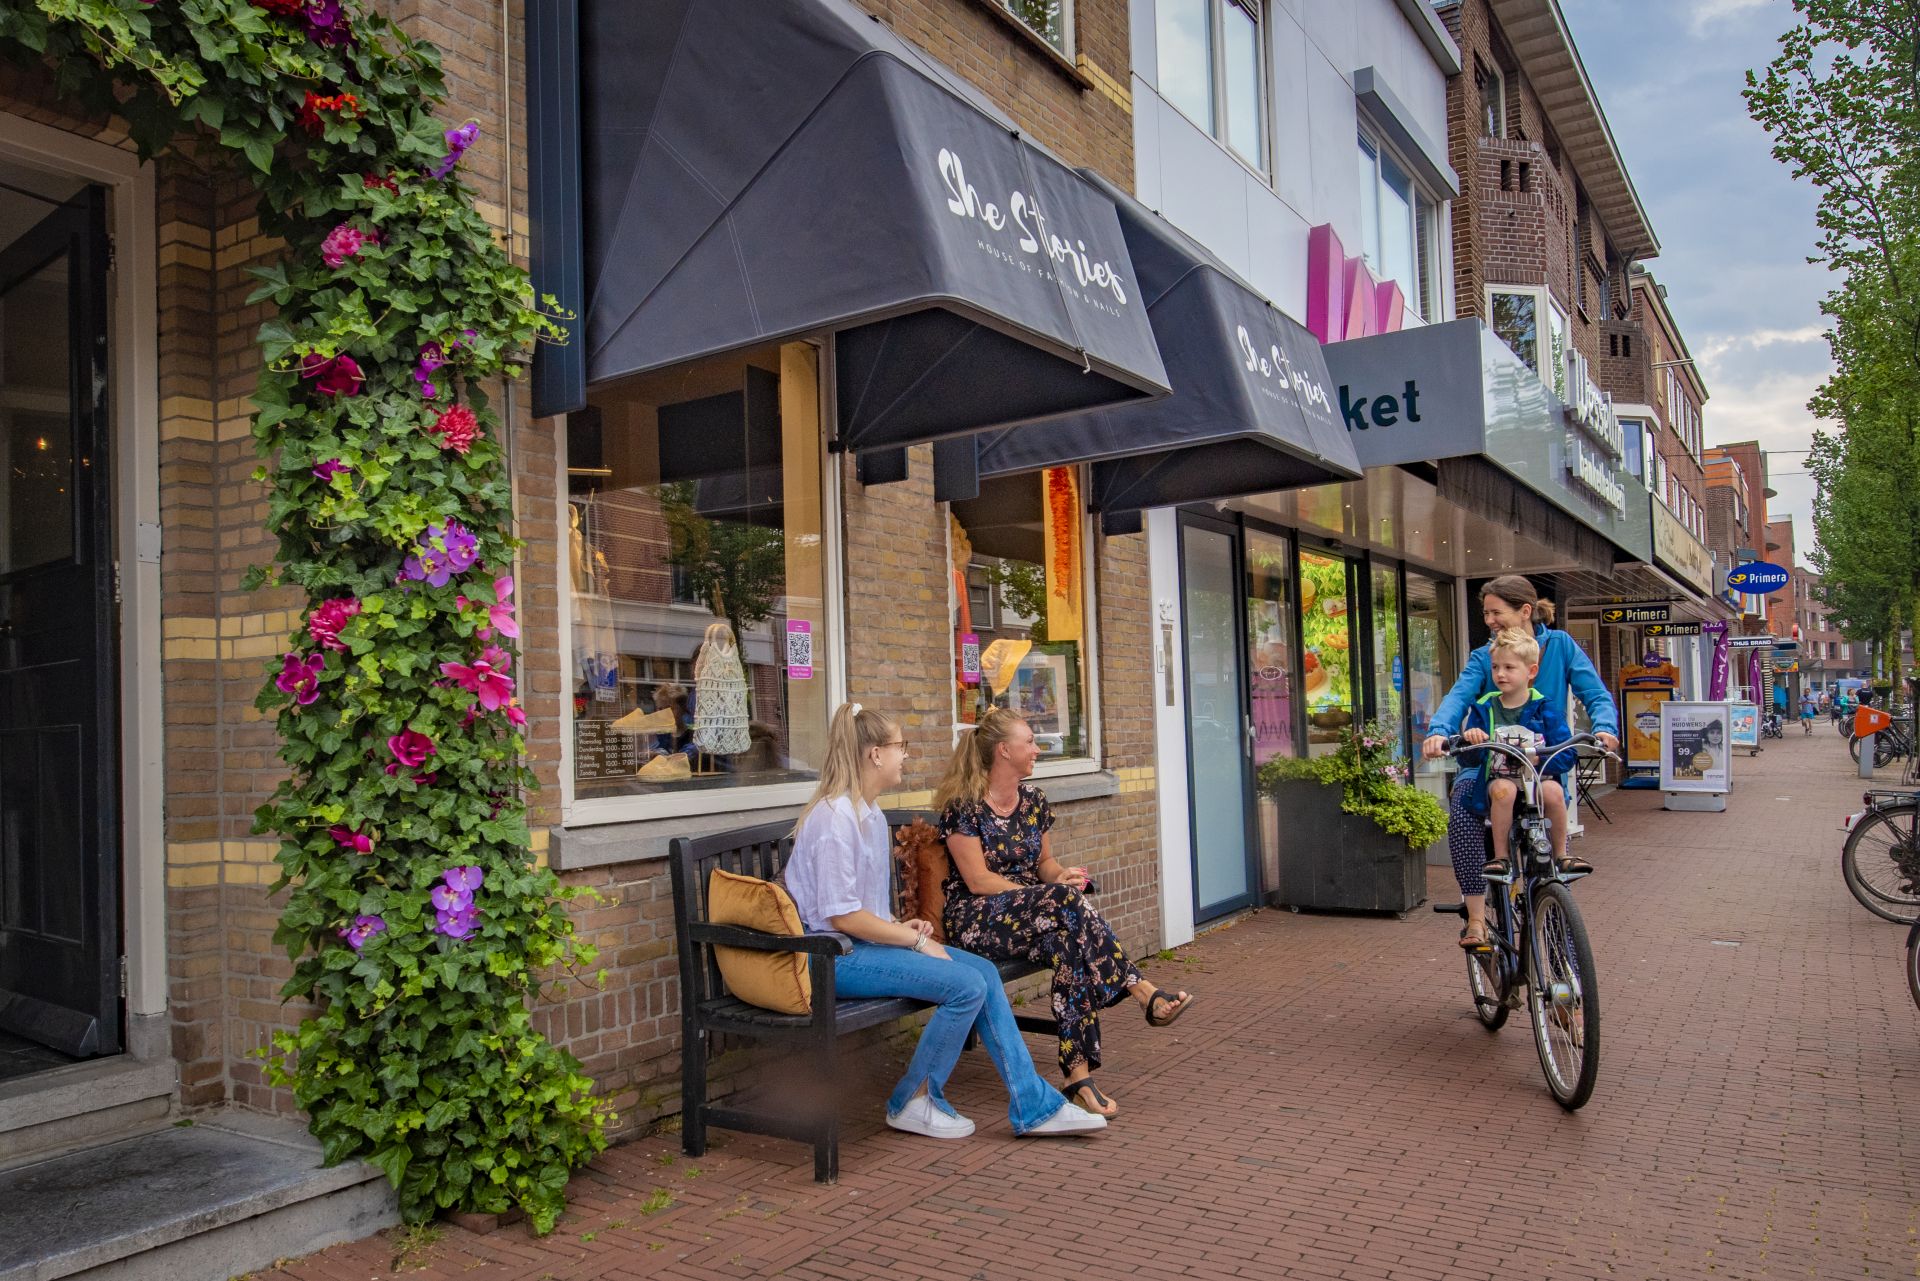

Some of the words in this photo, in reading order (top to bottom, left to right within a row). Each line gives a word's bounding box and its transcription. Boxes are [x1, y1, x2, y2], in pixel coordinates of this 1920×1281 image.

[938, 148, 1006, 231] She
[1010, 191, 1127, 305] Stories
[978, 239, 1014, 265] HOUSE
[1019, 261, 1033, 273] OF
[1093, 296, 1121, 318] NAILS
[1237, 324, 1272, 378] She
[1271, 344, 1332, 414] Stories
[1749, 571, 1788, 585] Primera
[1626, 608, 1668, 622] Primera
[1664, 624, 1699, 635] Primera
[1750, 638, 1772, 646] BRAND
